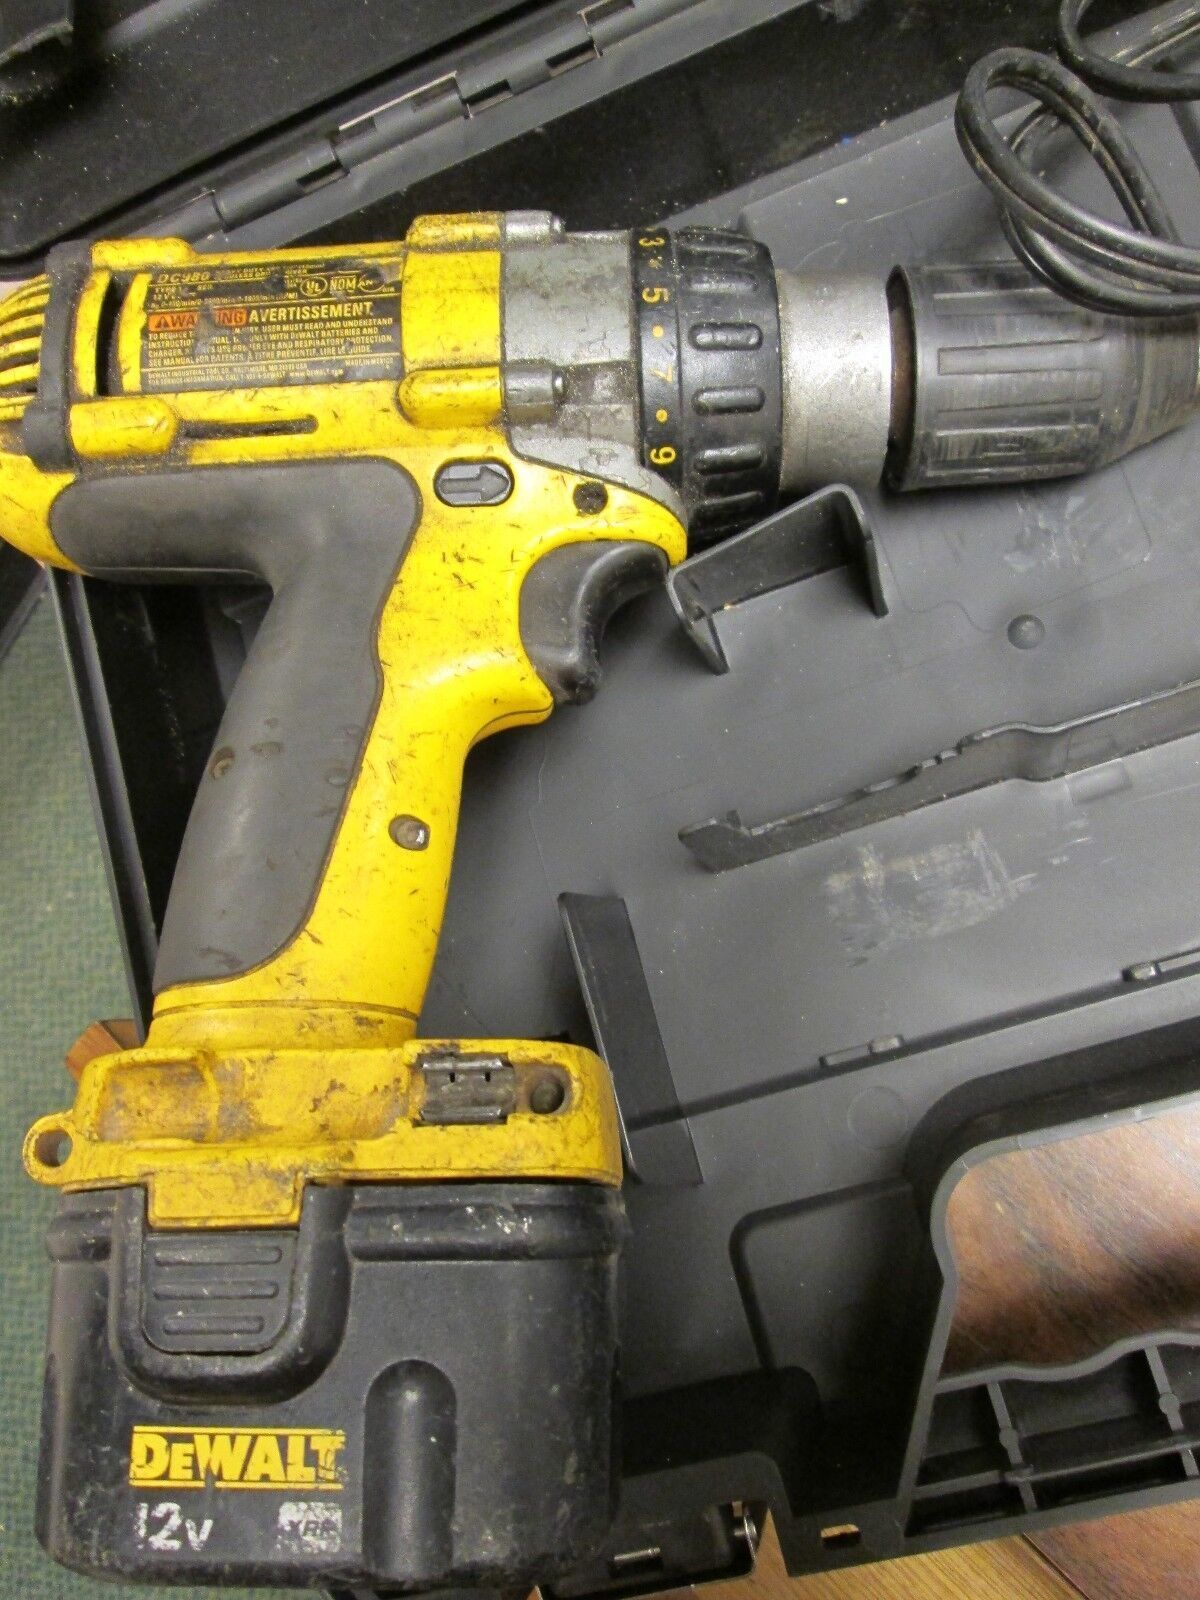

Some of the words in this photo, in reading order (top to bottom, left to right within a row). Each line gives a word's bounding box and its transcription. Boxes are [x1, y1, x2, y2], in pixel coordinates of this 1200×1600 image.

[642, 287, 671, 303] 5
[170, 309, 244, 328] WAING
[248, 301, 373, 323] AVERTISSEMENT
[282, 323, 303, 332] MUST
[304, 321, 324, 330] READ
[325, 320, 341, 329] AND
[342, 317, 393, 328] UNDERSTAND
[362, 327, 379, 335] AND
[277, 340, 293, 349] AND
[648, 362, 673, 384] 7
